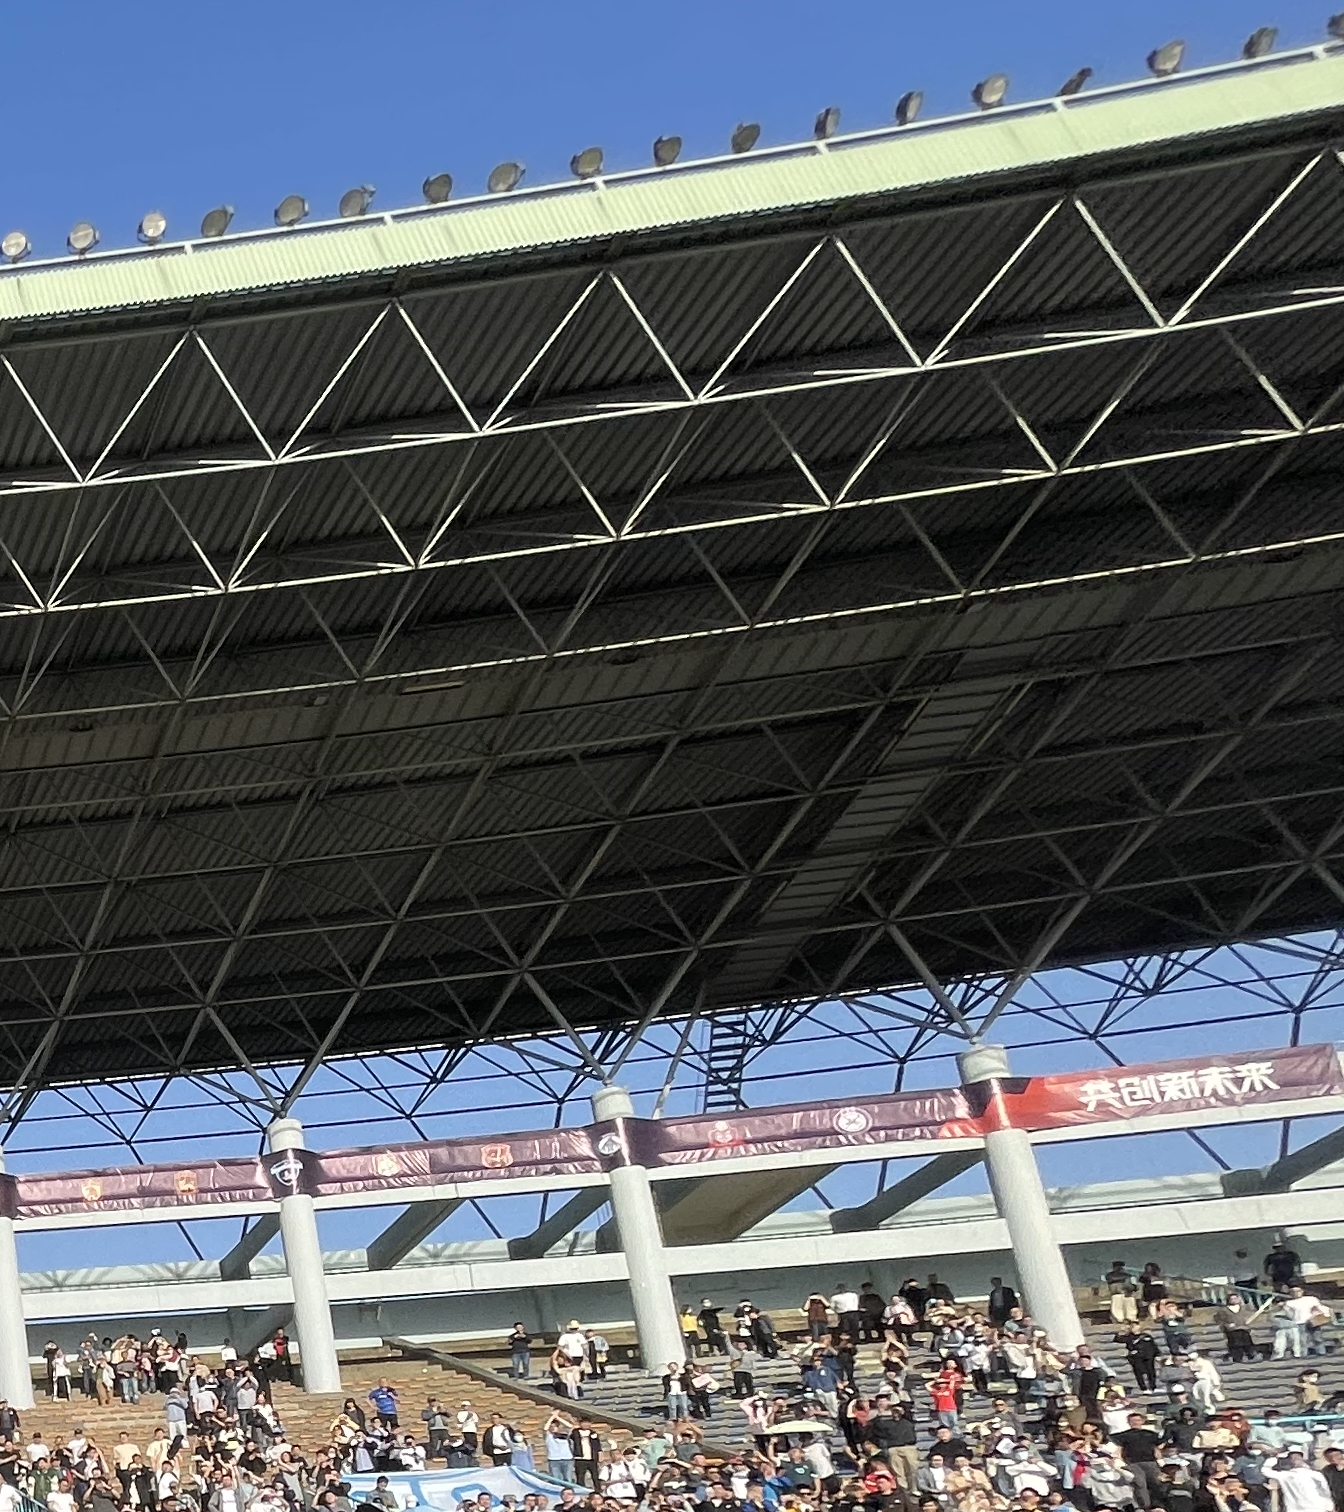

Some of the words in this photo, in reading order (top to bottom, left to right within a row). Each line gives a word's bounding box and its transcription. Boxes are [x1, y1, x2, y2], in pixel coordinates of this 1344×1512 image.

[1078, 1061, 1281, 1112] 共创新未来
